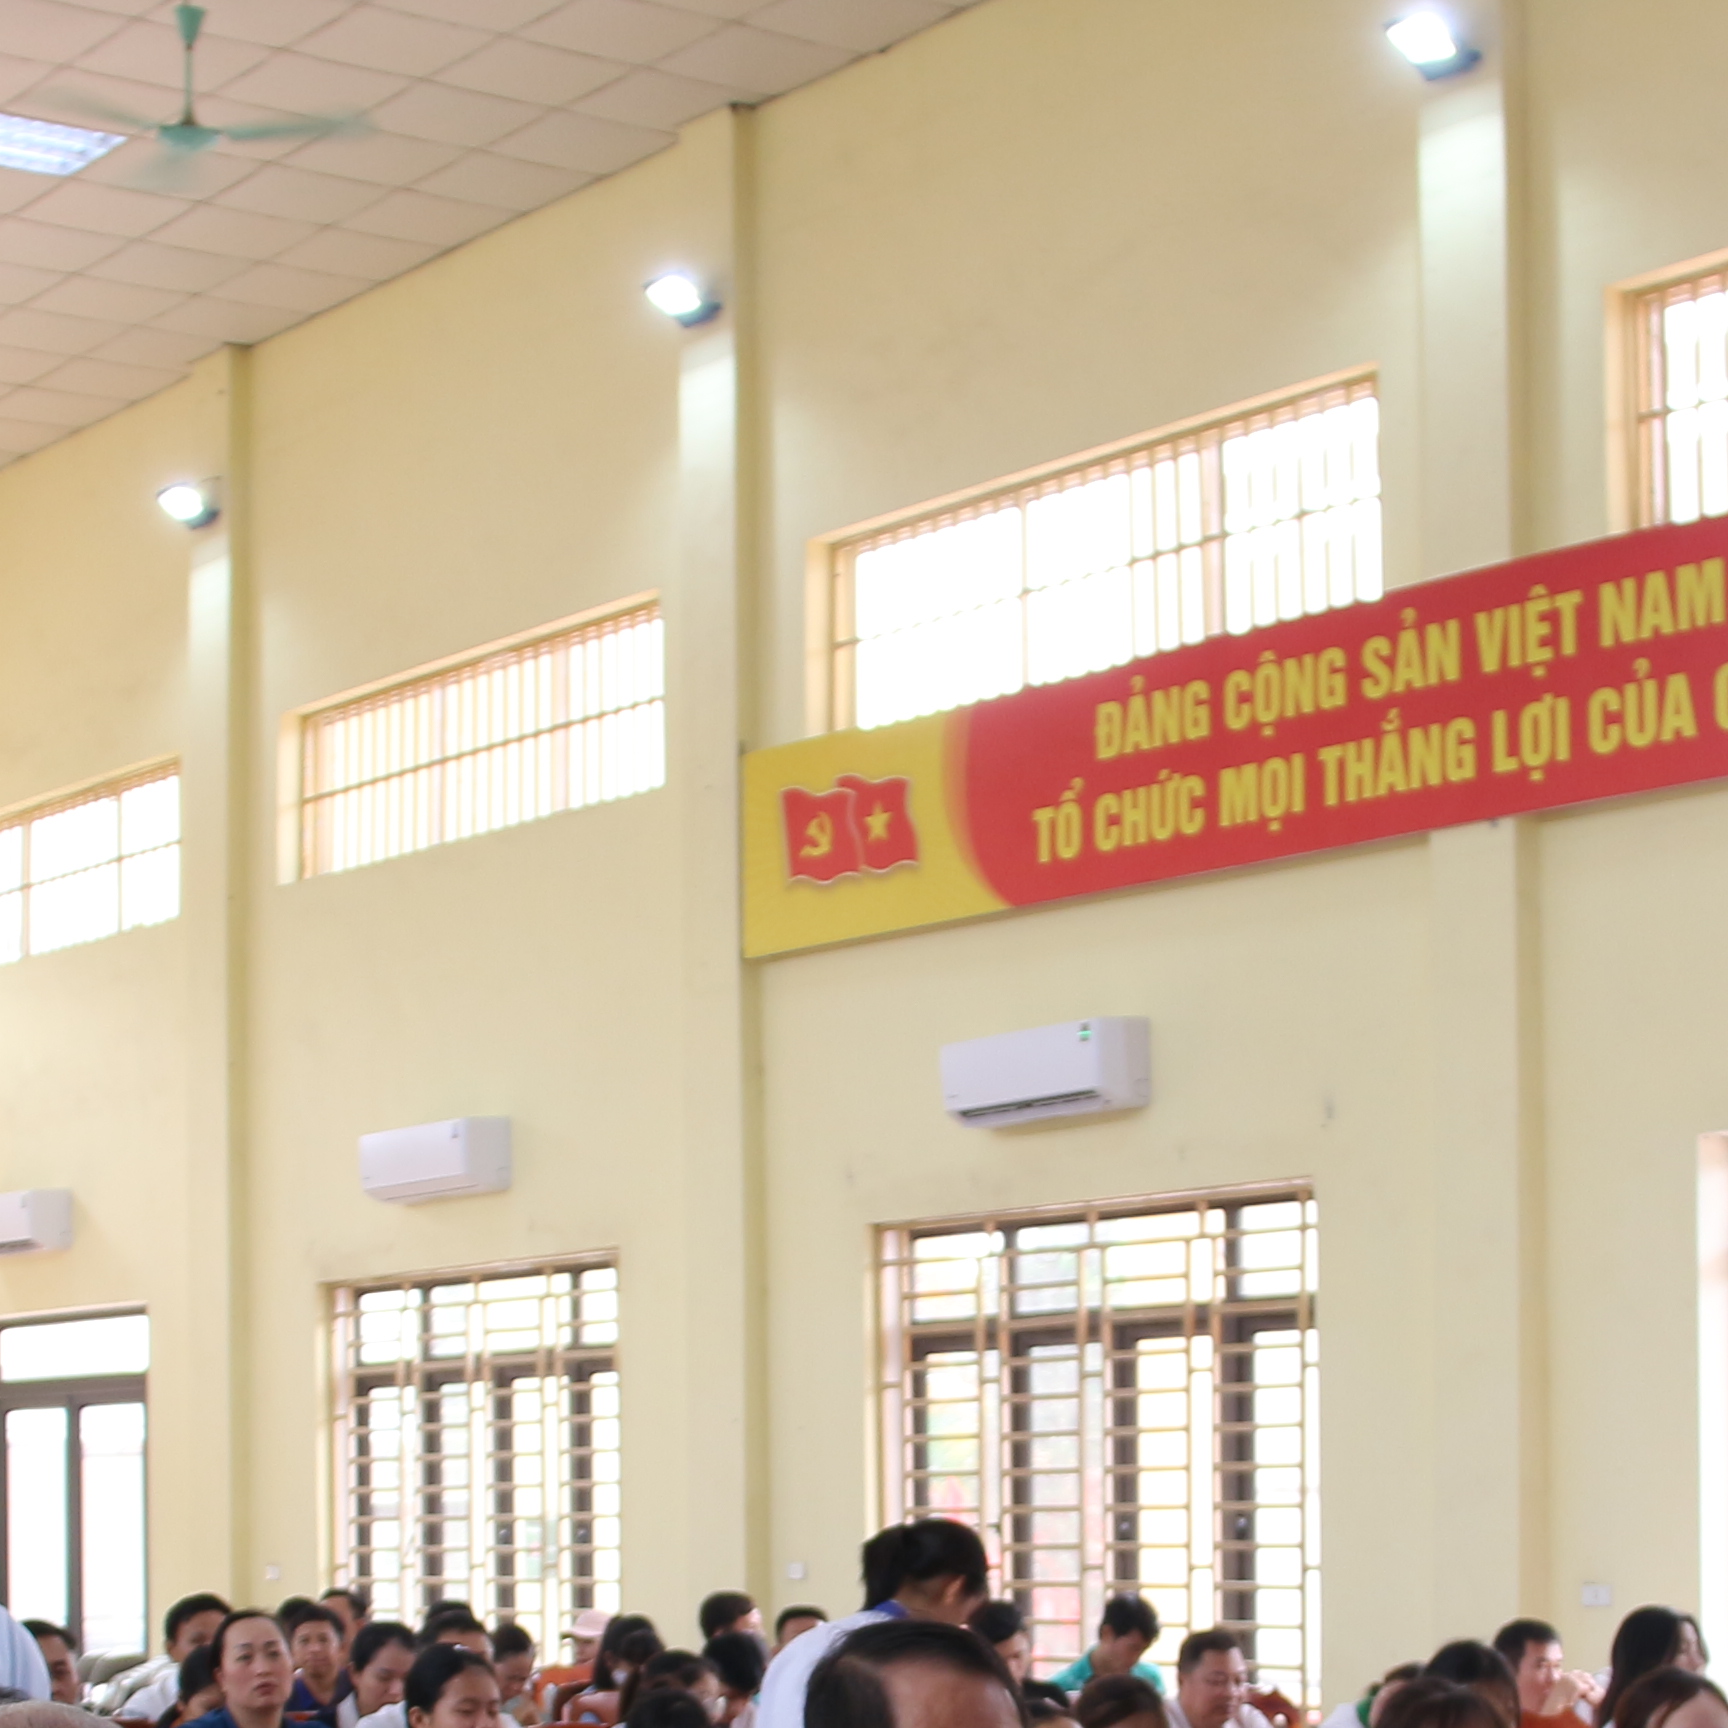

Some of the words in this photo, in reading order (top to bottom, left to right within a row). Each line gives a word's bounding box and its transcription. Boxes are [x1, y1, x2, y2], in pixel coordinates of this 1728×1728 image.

[1032, 778, 1083, 863] TỔ
[1093, 768, 1206, 851] CHỨC
[1218, 753, 1306, 832] MỌI
[1318, 708, 1477, 807] THẮNG
[1492, 694, 1571, 782] LỢI
[1587, 658, 1698, 754] CỦA
[1094, 675, 1211, 760] ĐẢNG
[1223, 650, 1347, 737] CỘNG
[1360, 607, 1461, 699] SẢN
[1474, 583, 1584, 676] VIỆT
[1598, 558, 1727, 647] NAM
